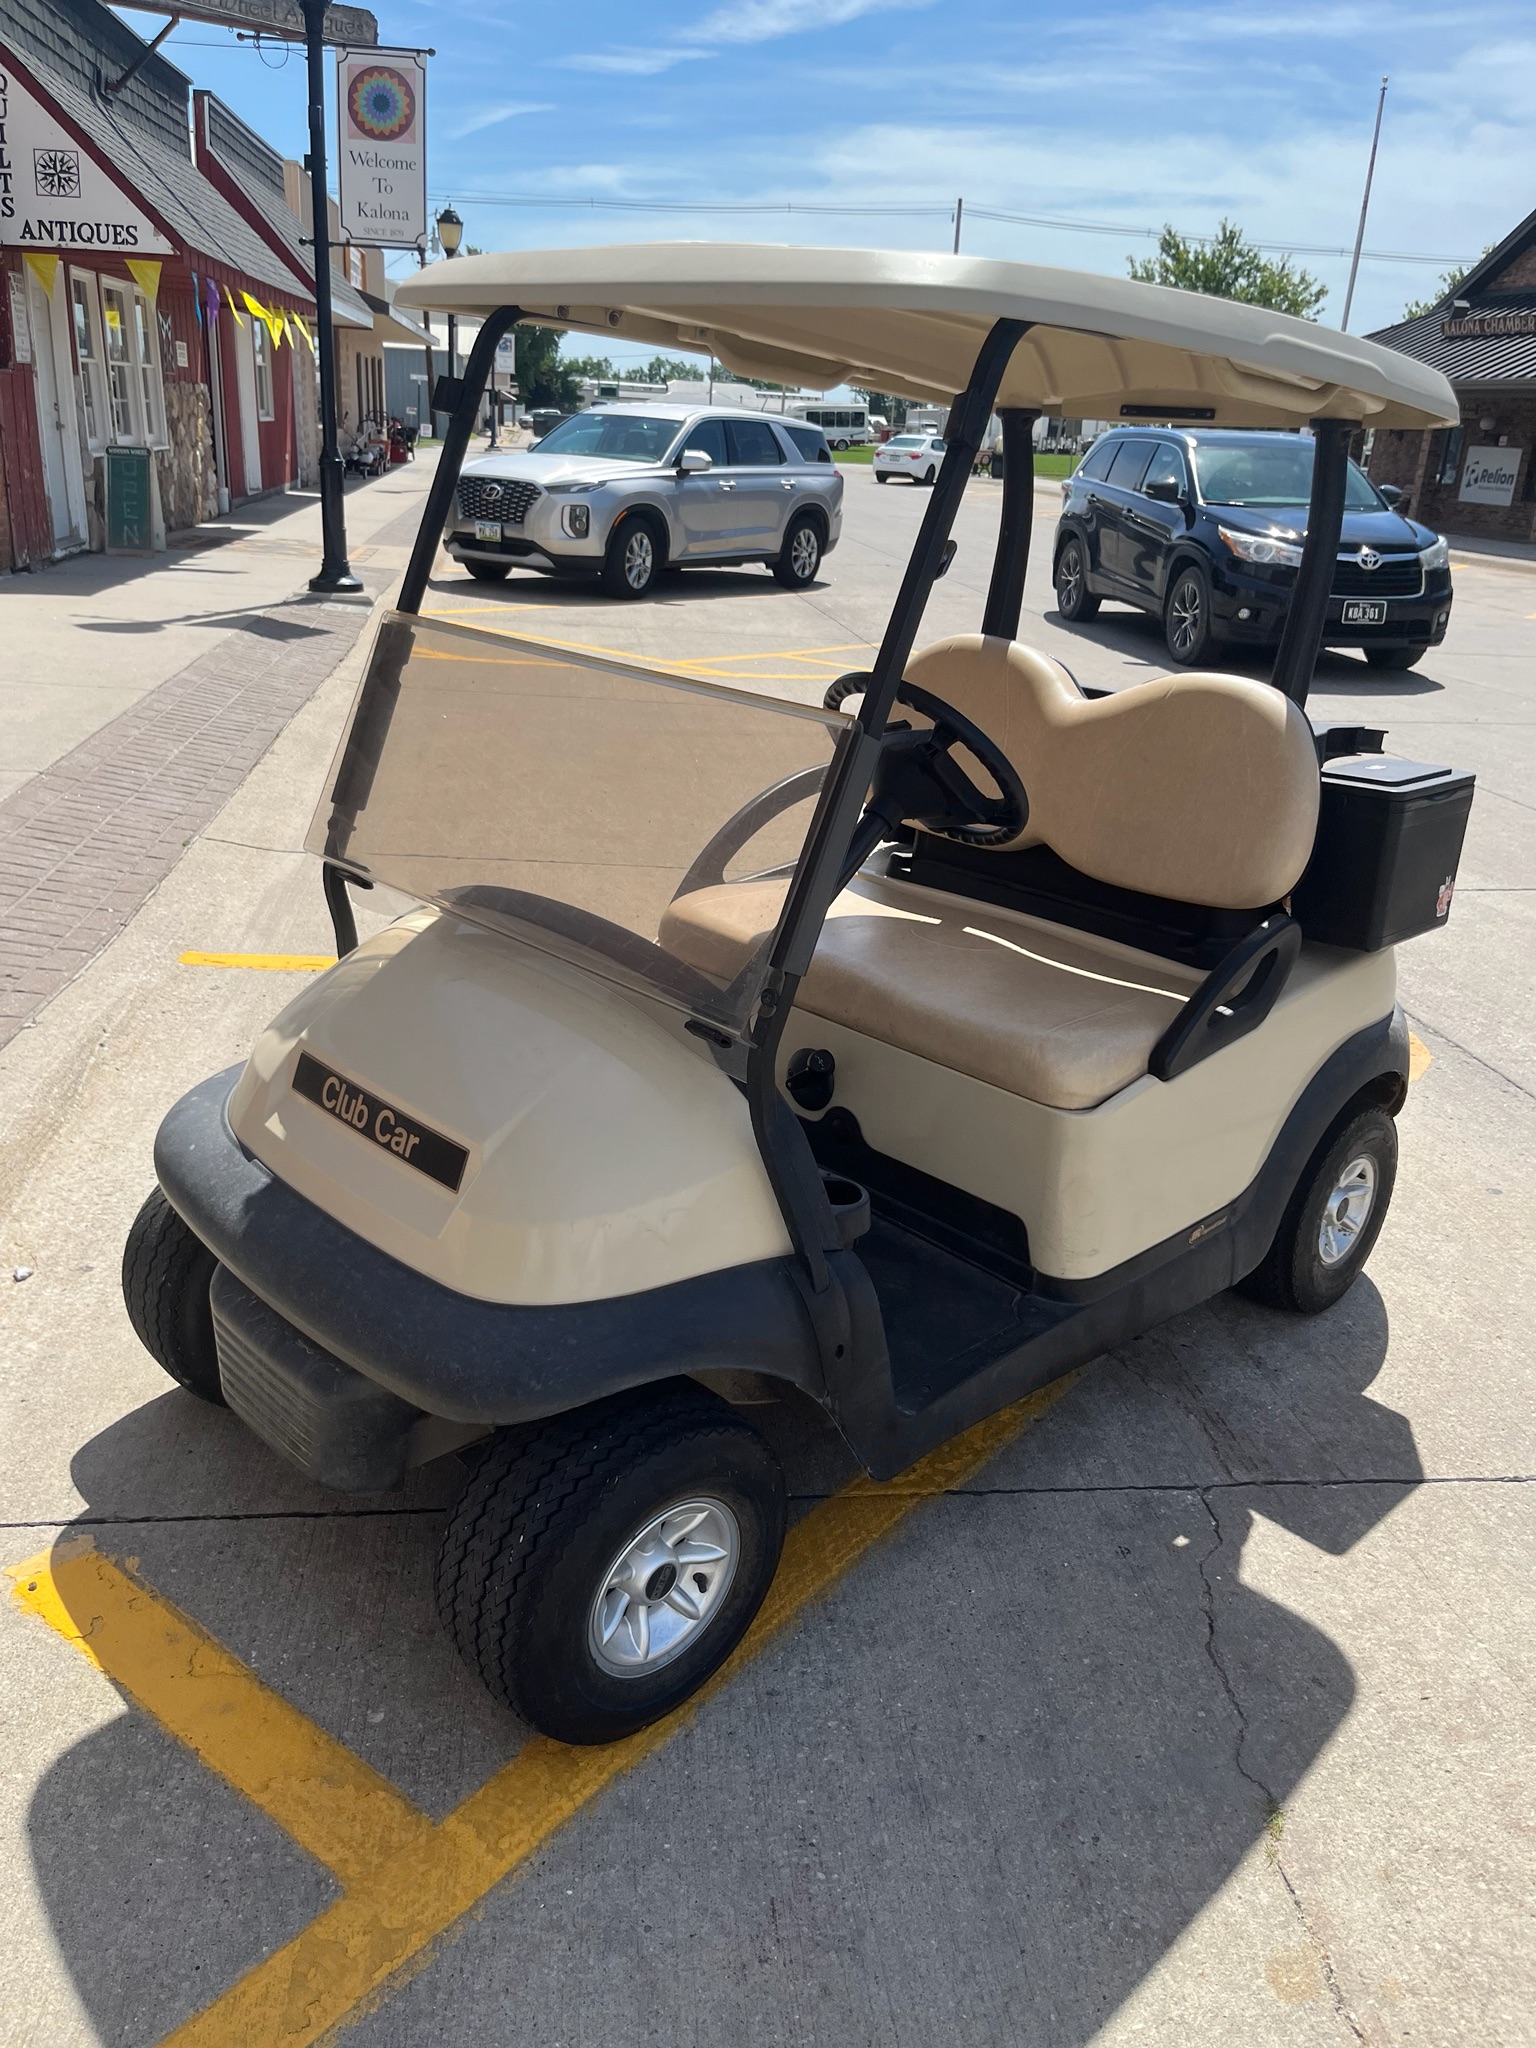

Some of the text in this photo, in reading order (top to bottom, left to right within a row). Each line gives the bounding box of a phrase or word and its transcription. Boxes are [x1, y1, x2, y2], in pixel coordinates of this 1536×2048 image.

[219, 0, 365, 36] Wheel Aques
[349, 150, 417, 171] Welcome
[372, 177, 393, 194] To
[357, 201, 409, 221] Kalona
[20, 219, 138, 246] ANTIQUES
[363, 227, 386, 236] SINCE
[1444, 315, 1535, 335] KALONA CHAMBER
[1480, 467, 1515, 486] Relion
[322, 1076, 420, 1158] Club Car
